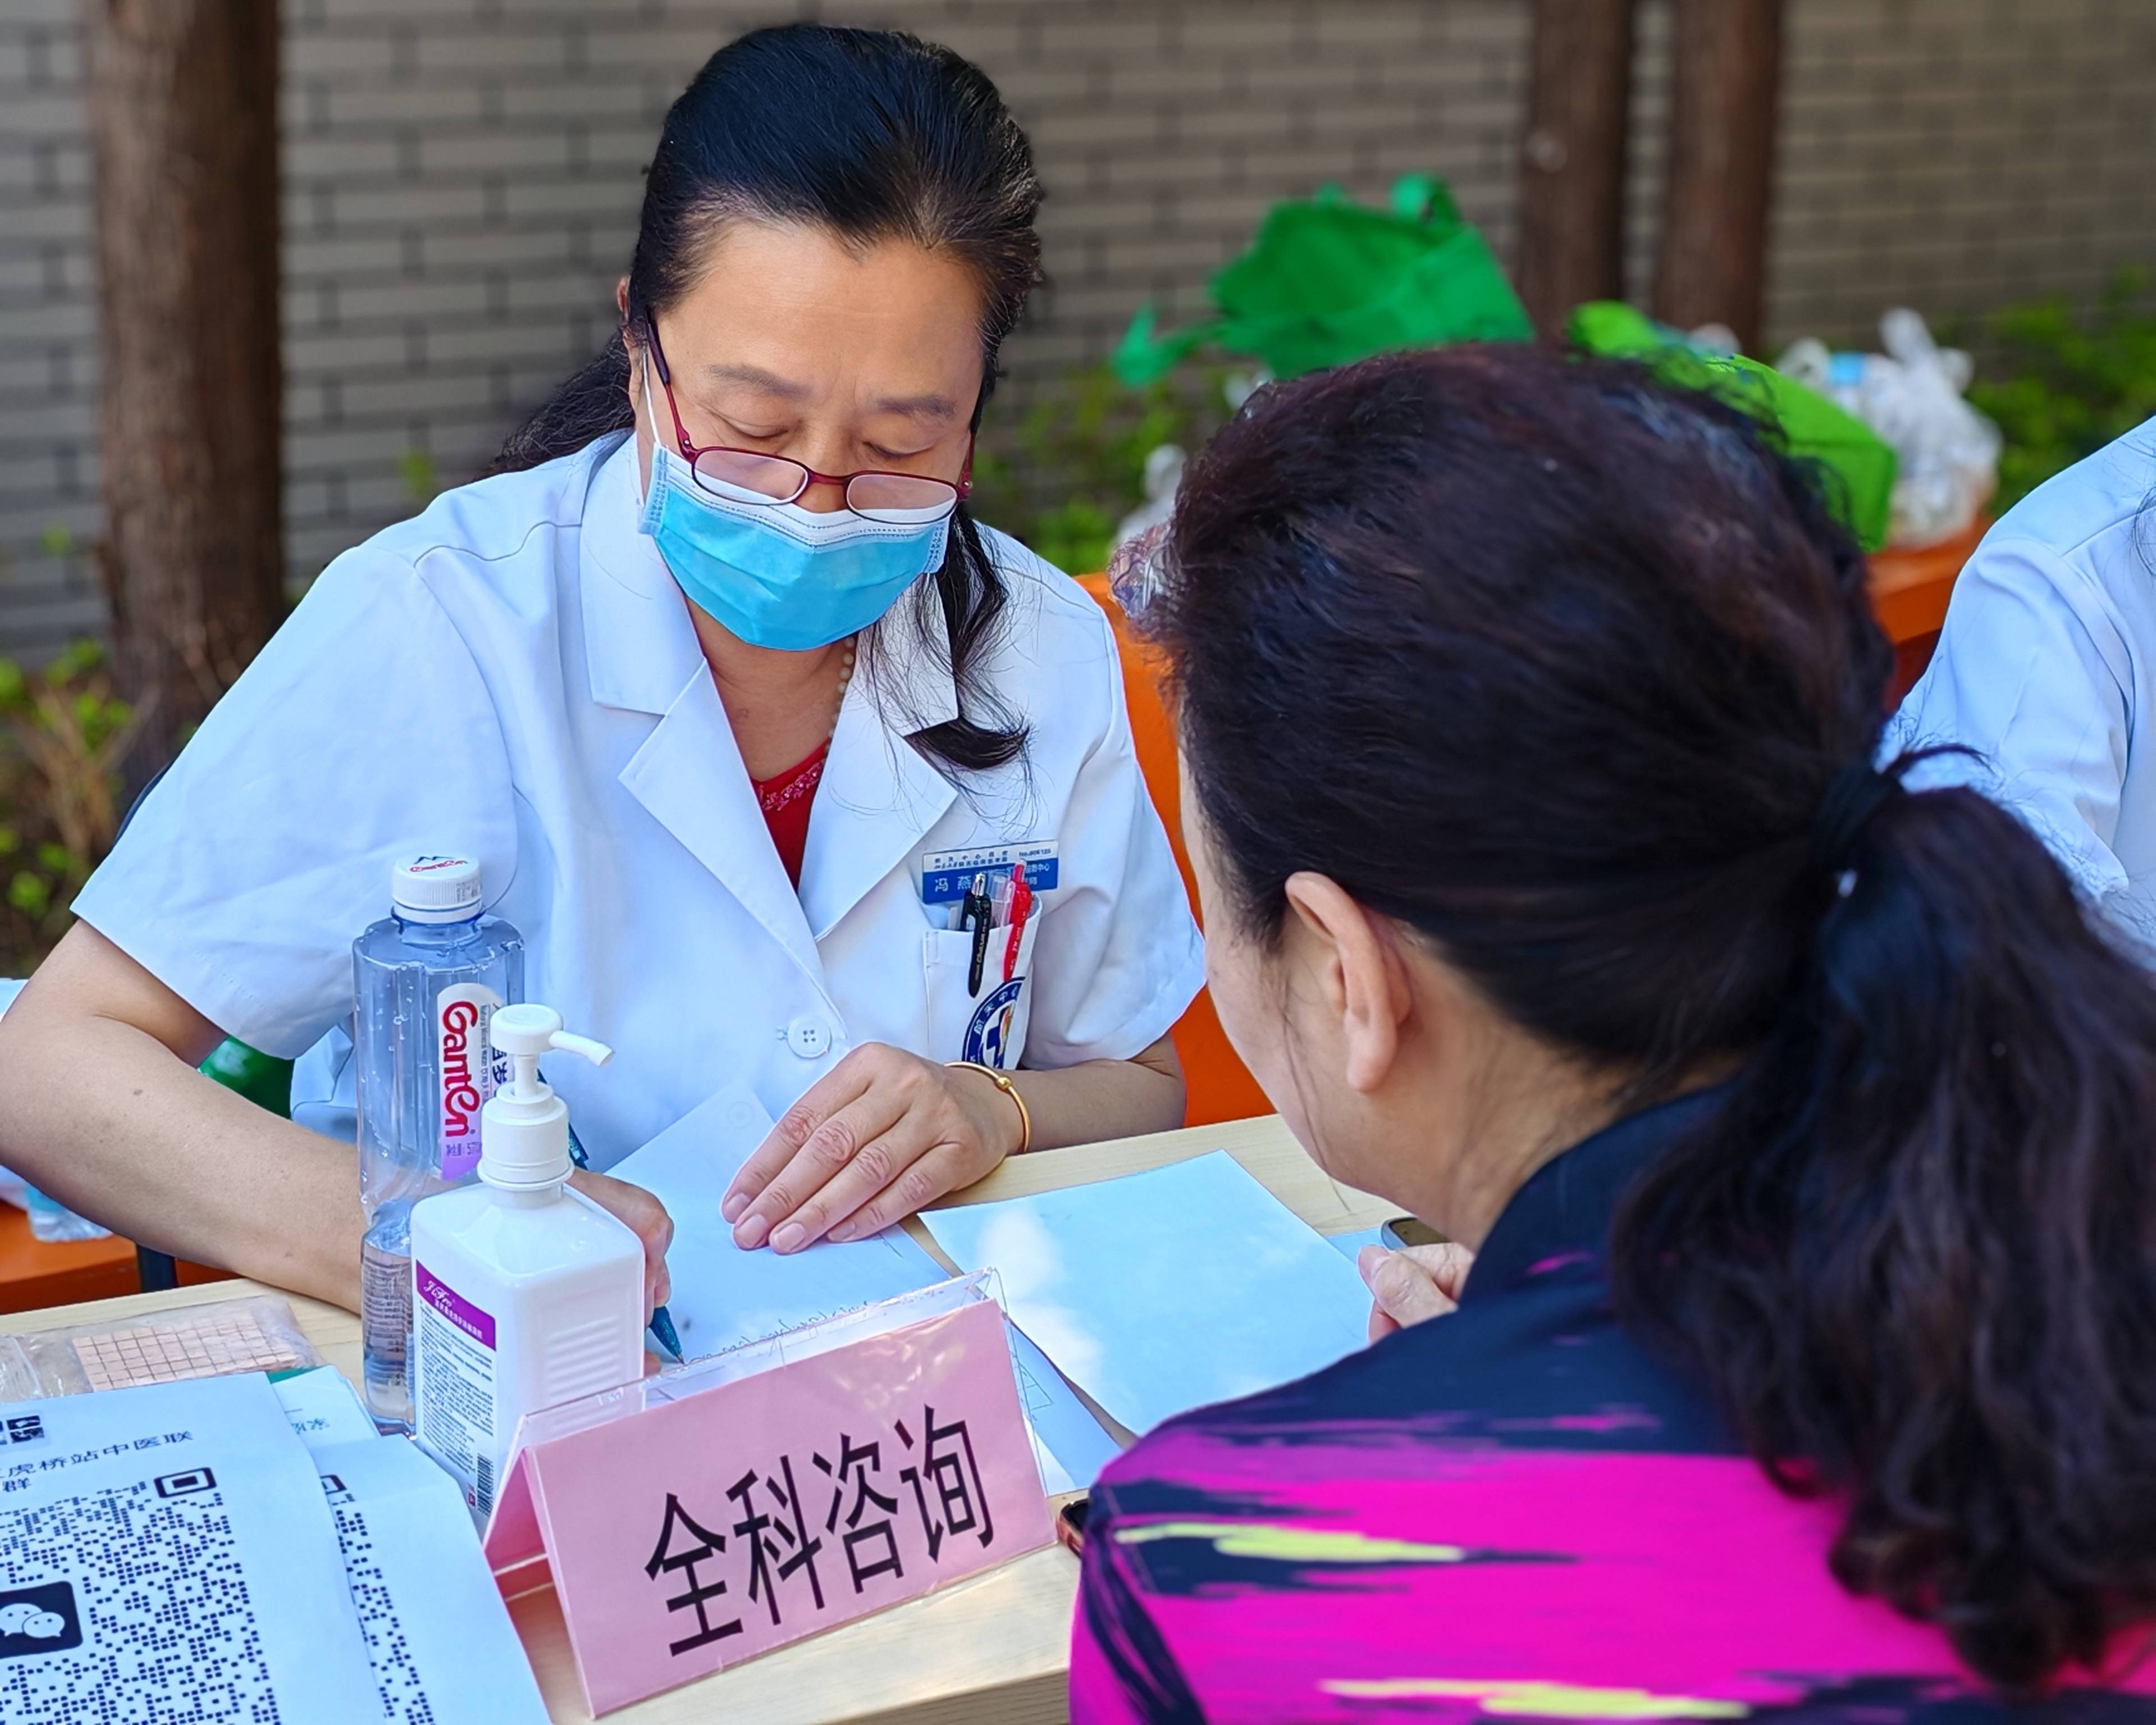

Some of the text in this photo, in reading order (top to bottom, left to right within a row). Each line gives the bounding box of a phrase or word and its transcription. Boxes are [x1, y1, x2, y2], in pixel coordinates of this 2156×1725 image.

[0, 1431, 193, 1478] 虎桥站中医联
[645, 1404, 995, 1656] 全科咨询
